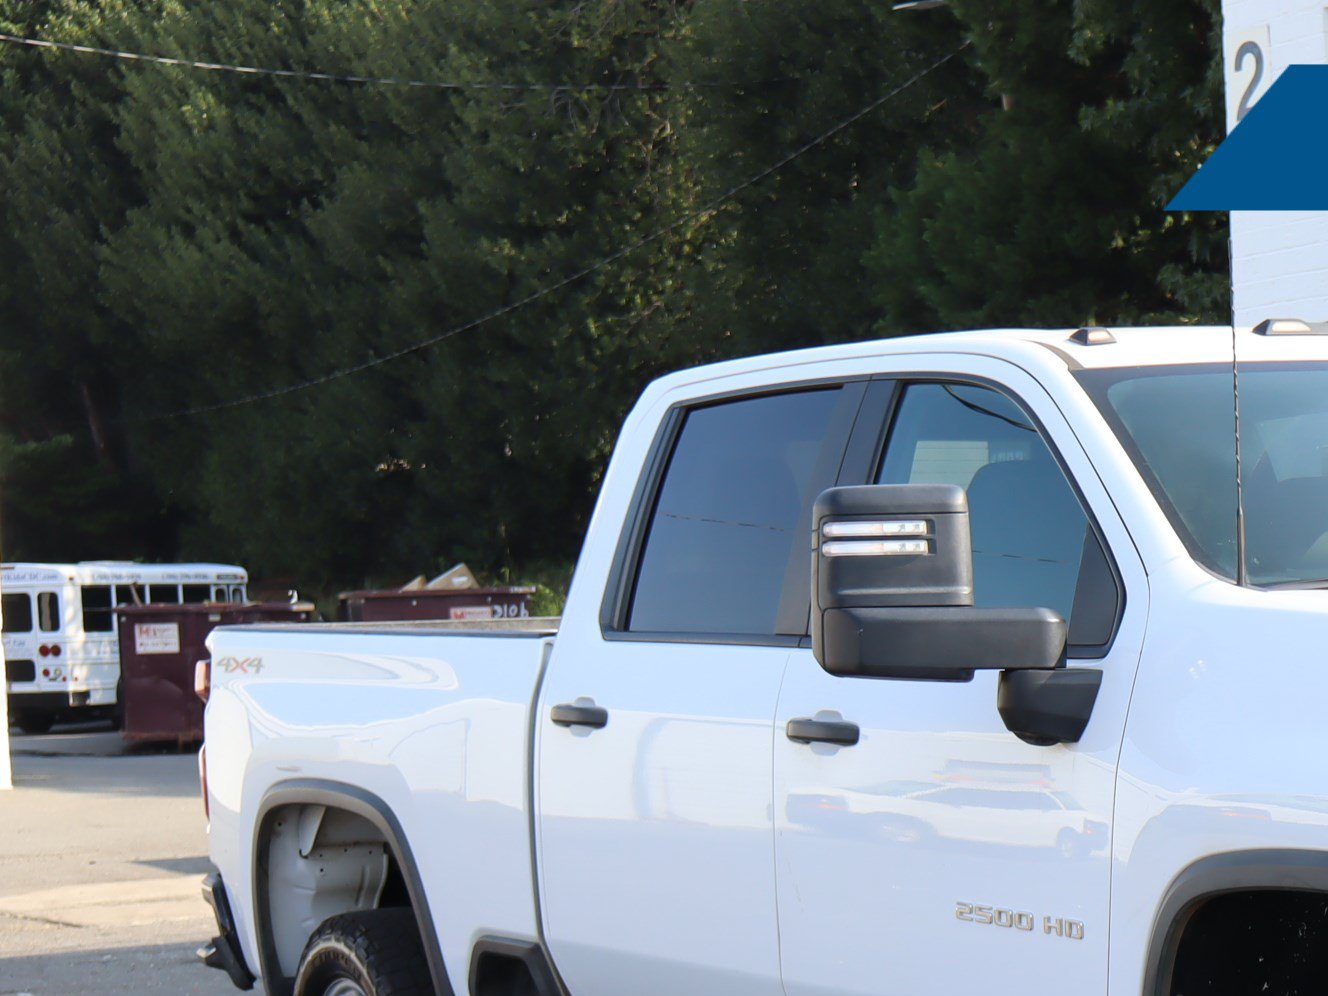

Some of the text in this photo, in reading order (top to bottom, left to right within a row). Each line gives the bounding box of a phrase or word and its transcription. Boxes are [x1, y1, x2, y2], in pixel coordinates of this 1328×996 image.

[1235, 41, 1264, 122] 2
[955, 901, 1085, 940] 2500 HD
